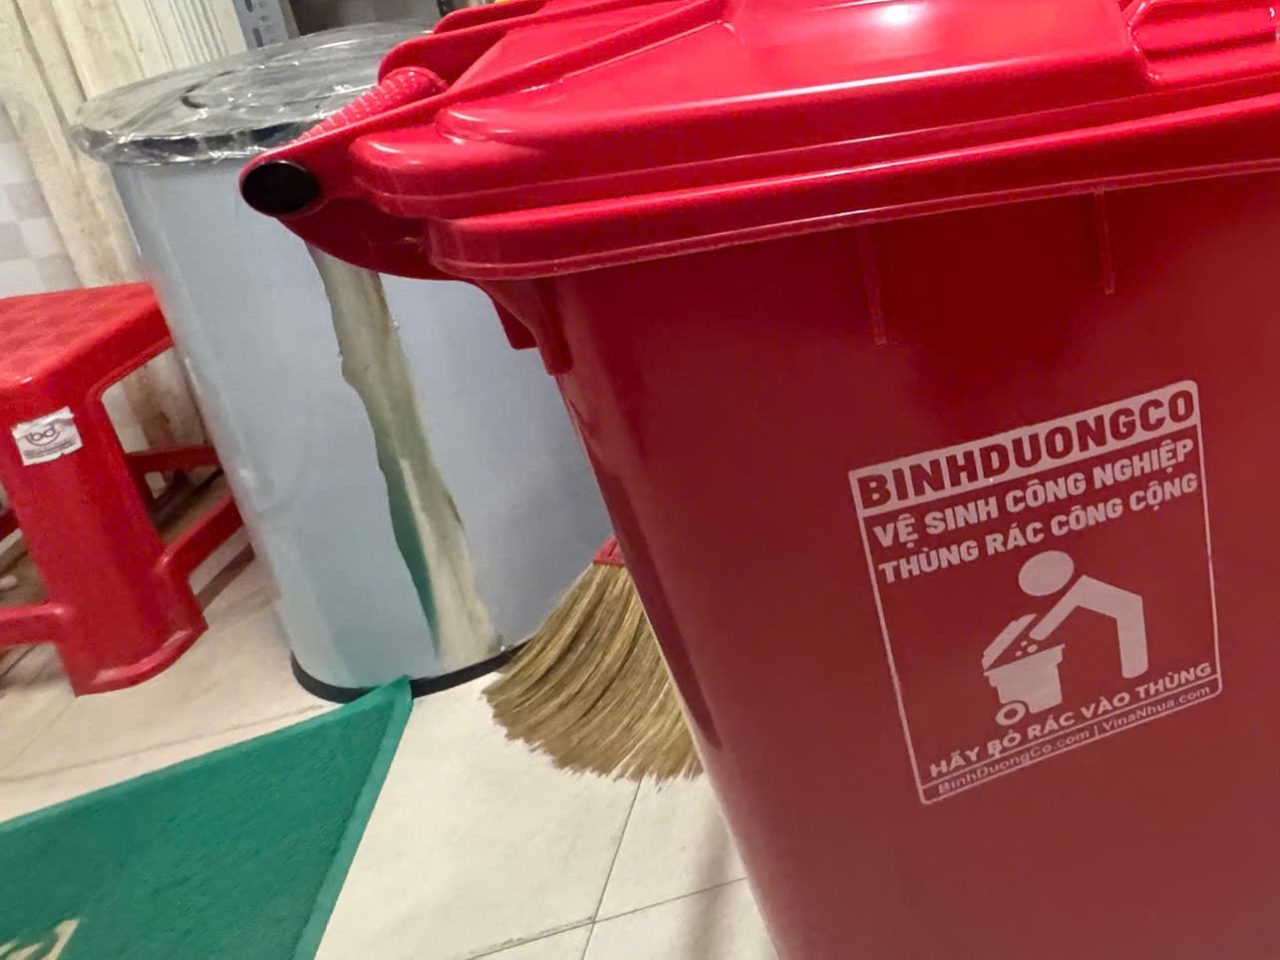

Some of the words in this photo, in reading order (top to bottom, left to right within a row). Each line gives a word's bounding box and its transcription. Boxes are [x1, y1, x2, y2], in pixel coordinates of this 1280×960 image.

[857, 390, 1194, 509] BINHDUONGCO
[873, 513, 919, 548] VỆ
[924, 496, 999, 535] SINH
[1005, 472, 1087, 513] CÔNG
[1092, 439, 1193, 489] NGHIỆP
[878, 540, 980, 584] THÙNG
[986, 521, 1044, 556] RÁC
[1051, 498, 1123, 536] CÔNG
[1129, 472, 1198, 511] CỘNG
[930, 747, 980, 778] HÃY
[987, 730, 1021, 758] BỎ
[1027, 711, 1075, 740] RÁC
[1080, 692, 1131, 719] VÀO
[1135, 662, 1212, 699] THÙNG
[938, 729, 1090, 794] BinhDuongCo.com
[1102, 686, 1210, 731] VinaNhua.com
